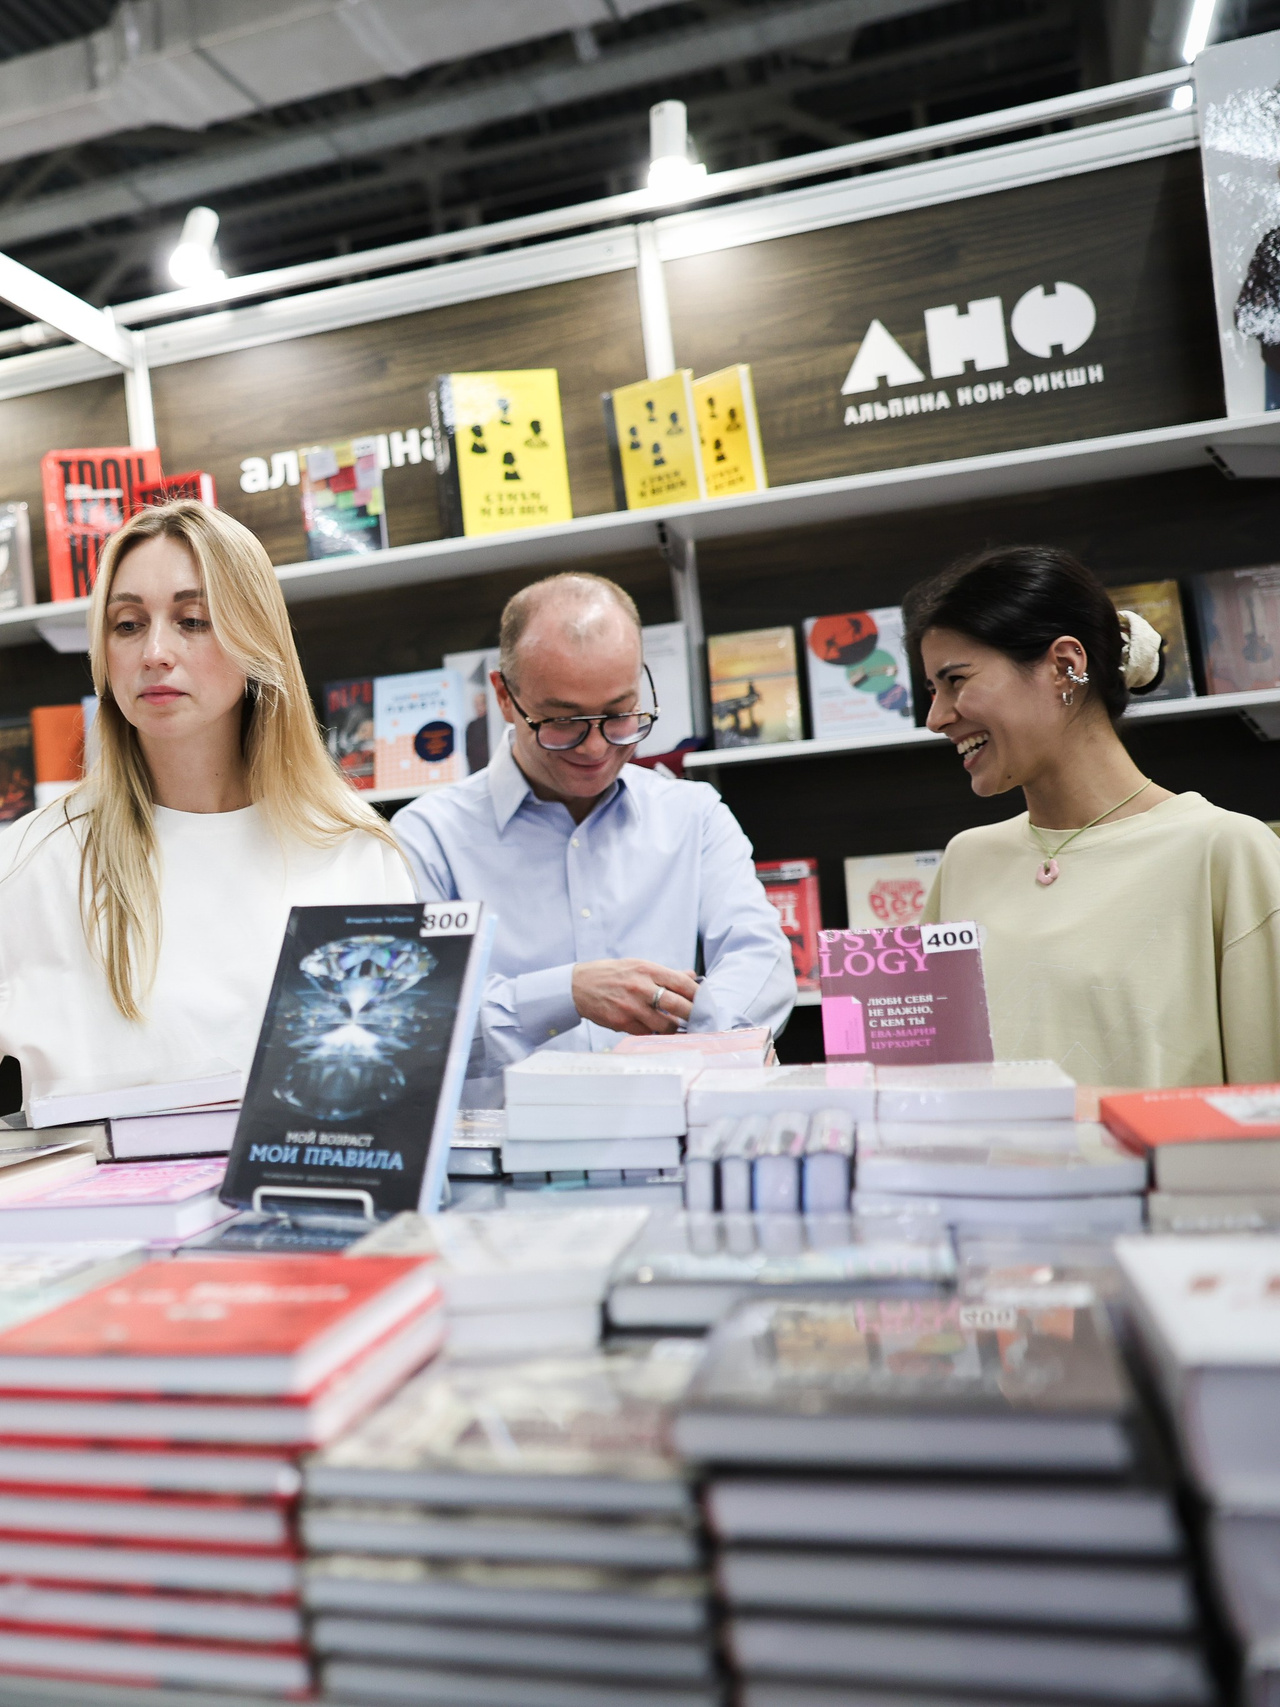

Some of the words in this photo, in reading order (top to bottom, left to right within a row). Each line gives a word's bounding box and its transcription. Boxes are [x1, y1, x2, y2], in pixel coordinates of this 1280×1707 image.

[841, 280, 1096, 395] АНО
[844, 389, 951, 426] АЛЬПИНА
[957, 363, 1104, 408] НОН-ФИКШН
[926, 930, 973, 948] 400
[820, 948, 930, 978] LOGY
[867, 996, 902, 1007] ЛЮБИ
[904, 995, 933, 1004] СЕБЯ
[868, 1007, 884, 1017] НЕ
[887, 1006, 934, 1017] ВАЖНО,
[869, 1019, 878, 1029] С
[880, 1018, 905, 1027] КЕМ
[908, 1016, 926, 1026] ТЫ
[870, 1027, 937, 1039] ЕВА-МАРИЯ
[871, 1038, 932, 1050] ЦУРХОРСТ
[285, 1130, 316, 1145] МОЙ
[318, 1132, 374, 1148] ВОЗРАСТ
[249, 1143, 300, 1164] МОИ
[303, 1146, 405, 1171] ПРАВИЛА
